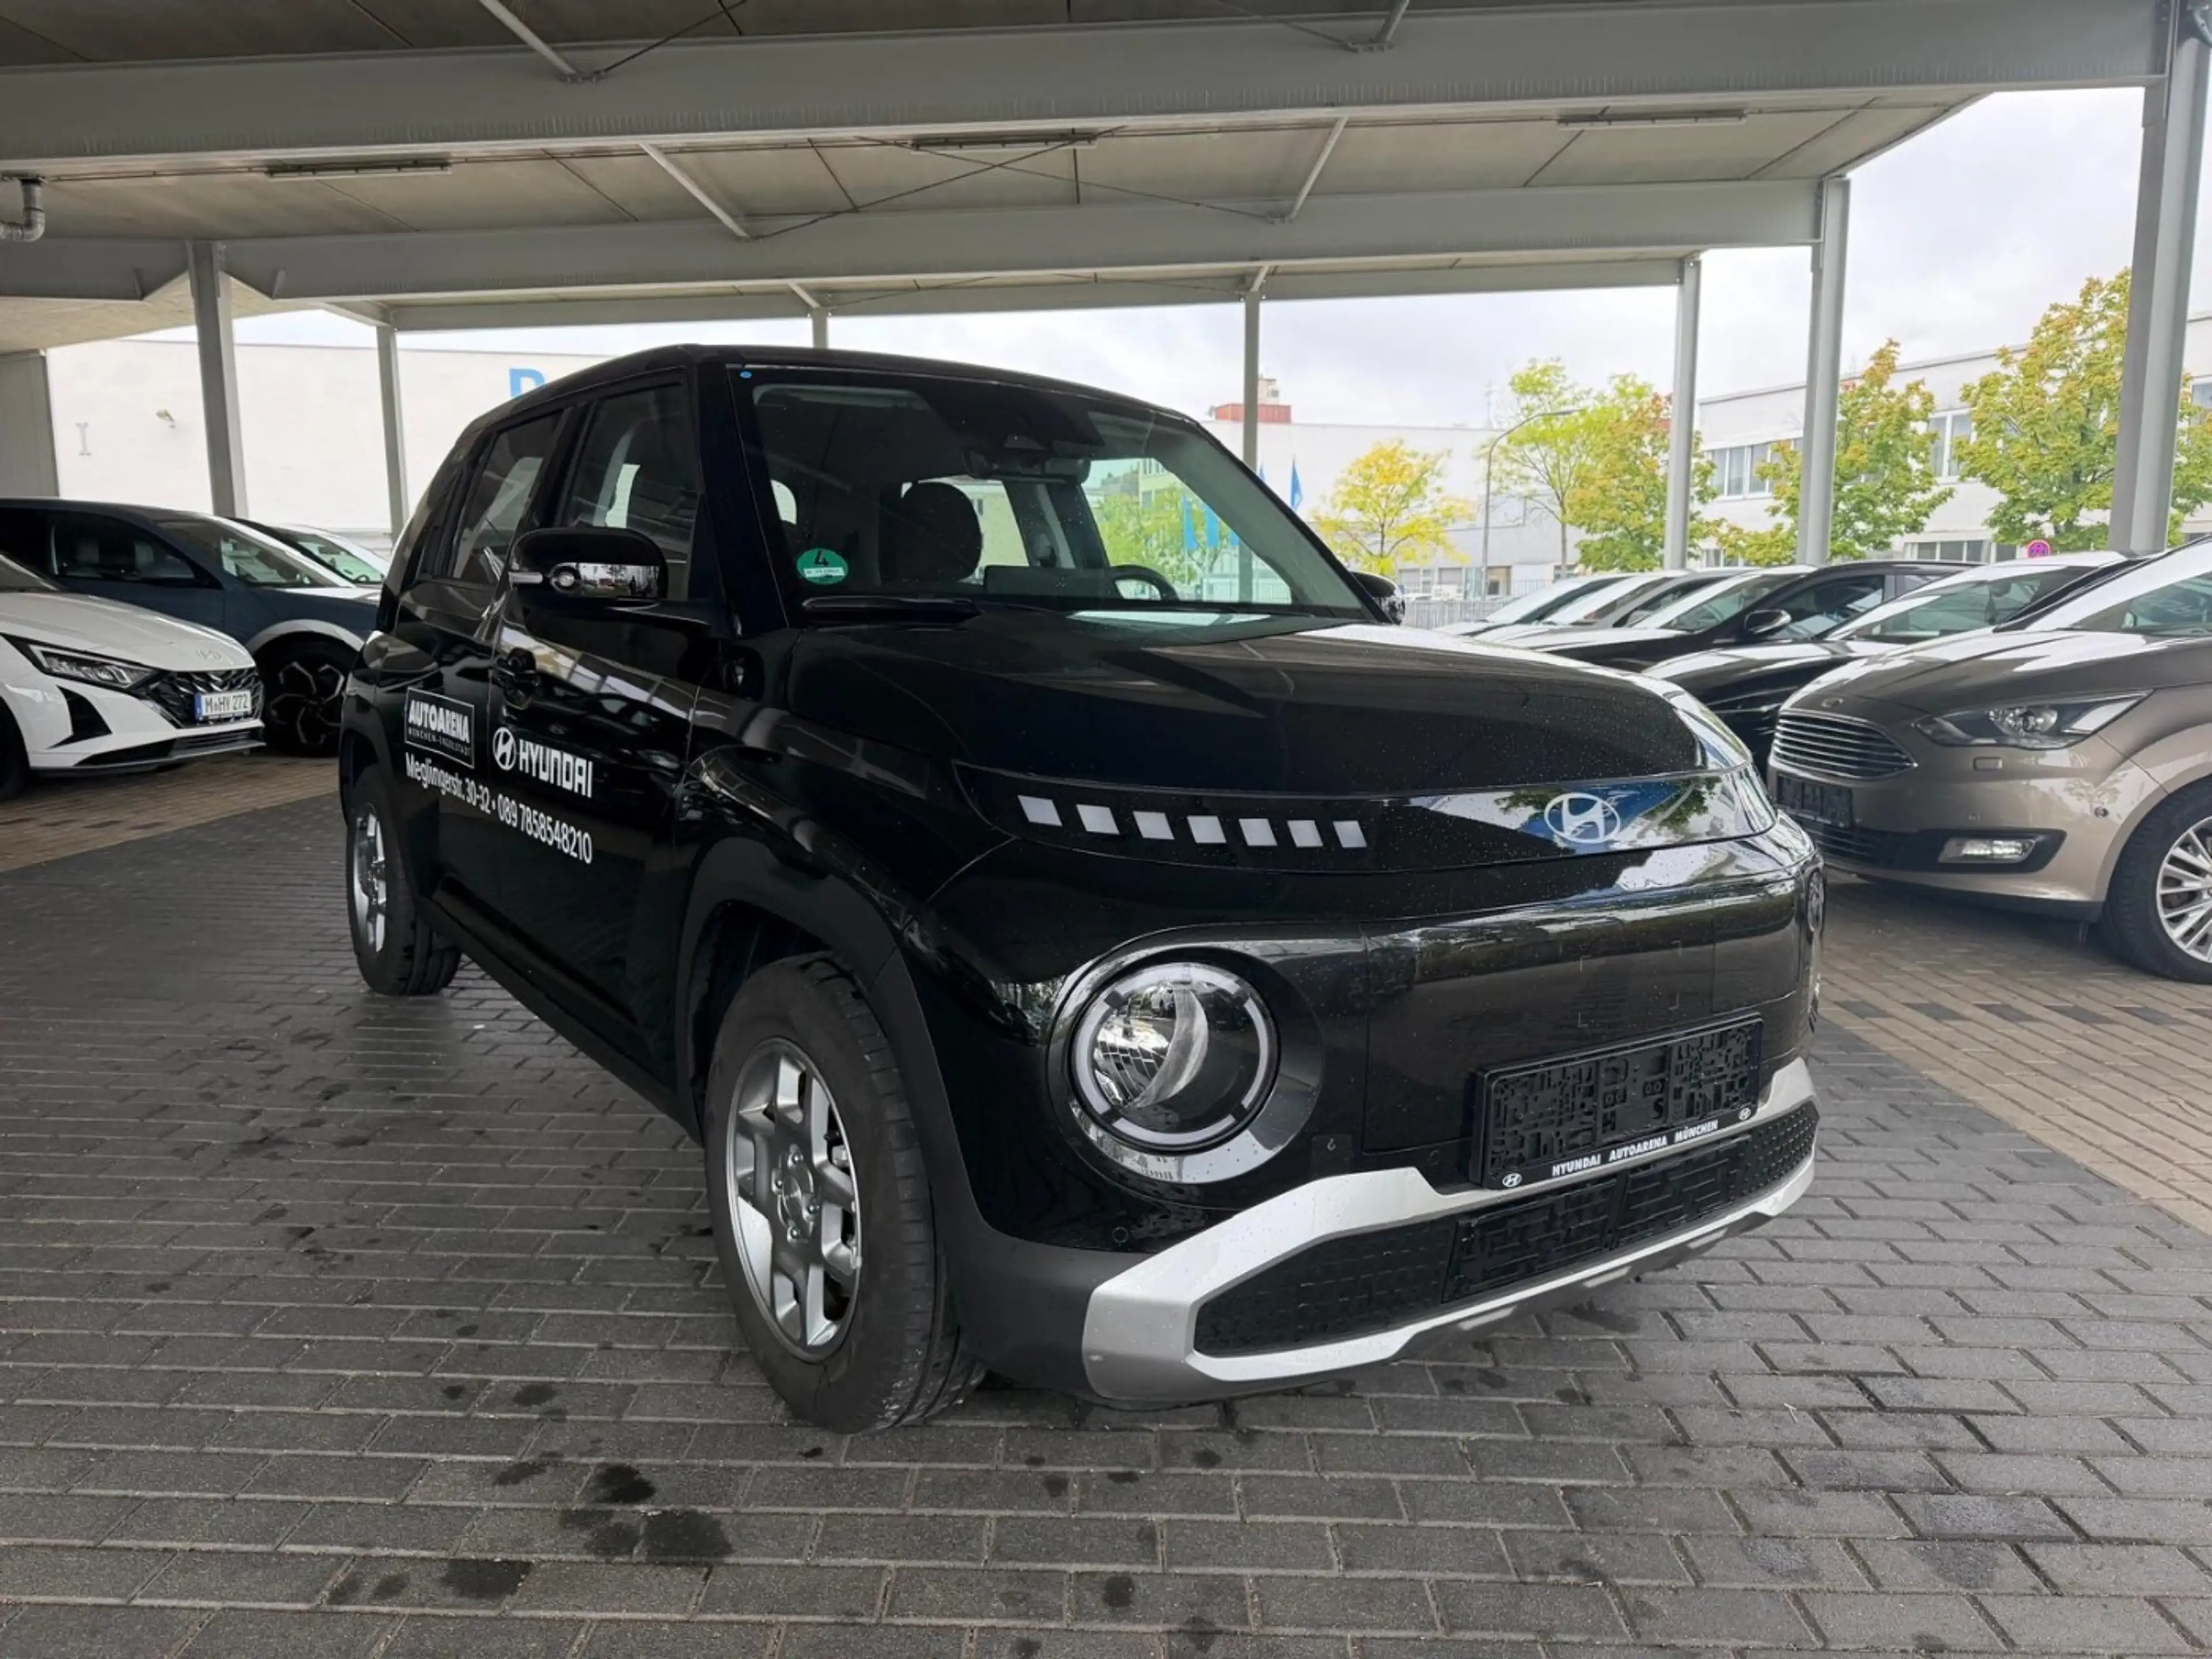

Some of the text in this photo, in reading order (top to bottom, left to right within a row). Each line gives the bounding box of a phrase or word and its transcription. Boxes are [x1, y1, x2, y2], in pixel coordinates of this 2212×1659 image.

[813, 550, 830, 566] 4
[232, 693, 249, 710] 272
[408, 699, 470, 744] AUTOARENA
[519, 738, 593, 798] HYUNDAI
[464, 778, 491, 814] 30-32
[497, 793, 518, 828] 089
[518, 802, 592, 864] 7858548210
[1552, 1119, 1719, 1176] HYUNDAI AUTOARENA MÜNCHEN
